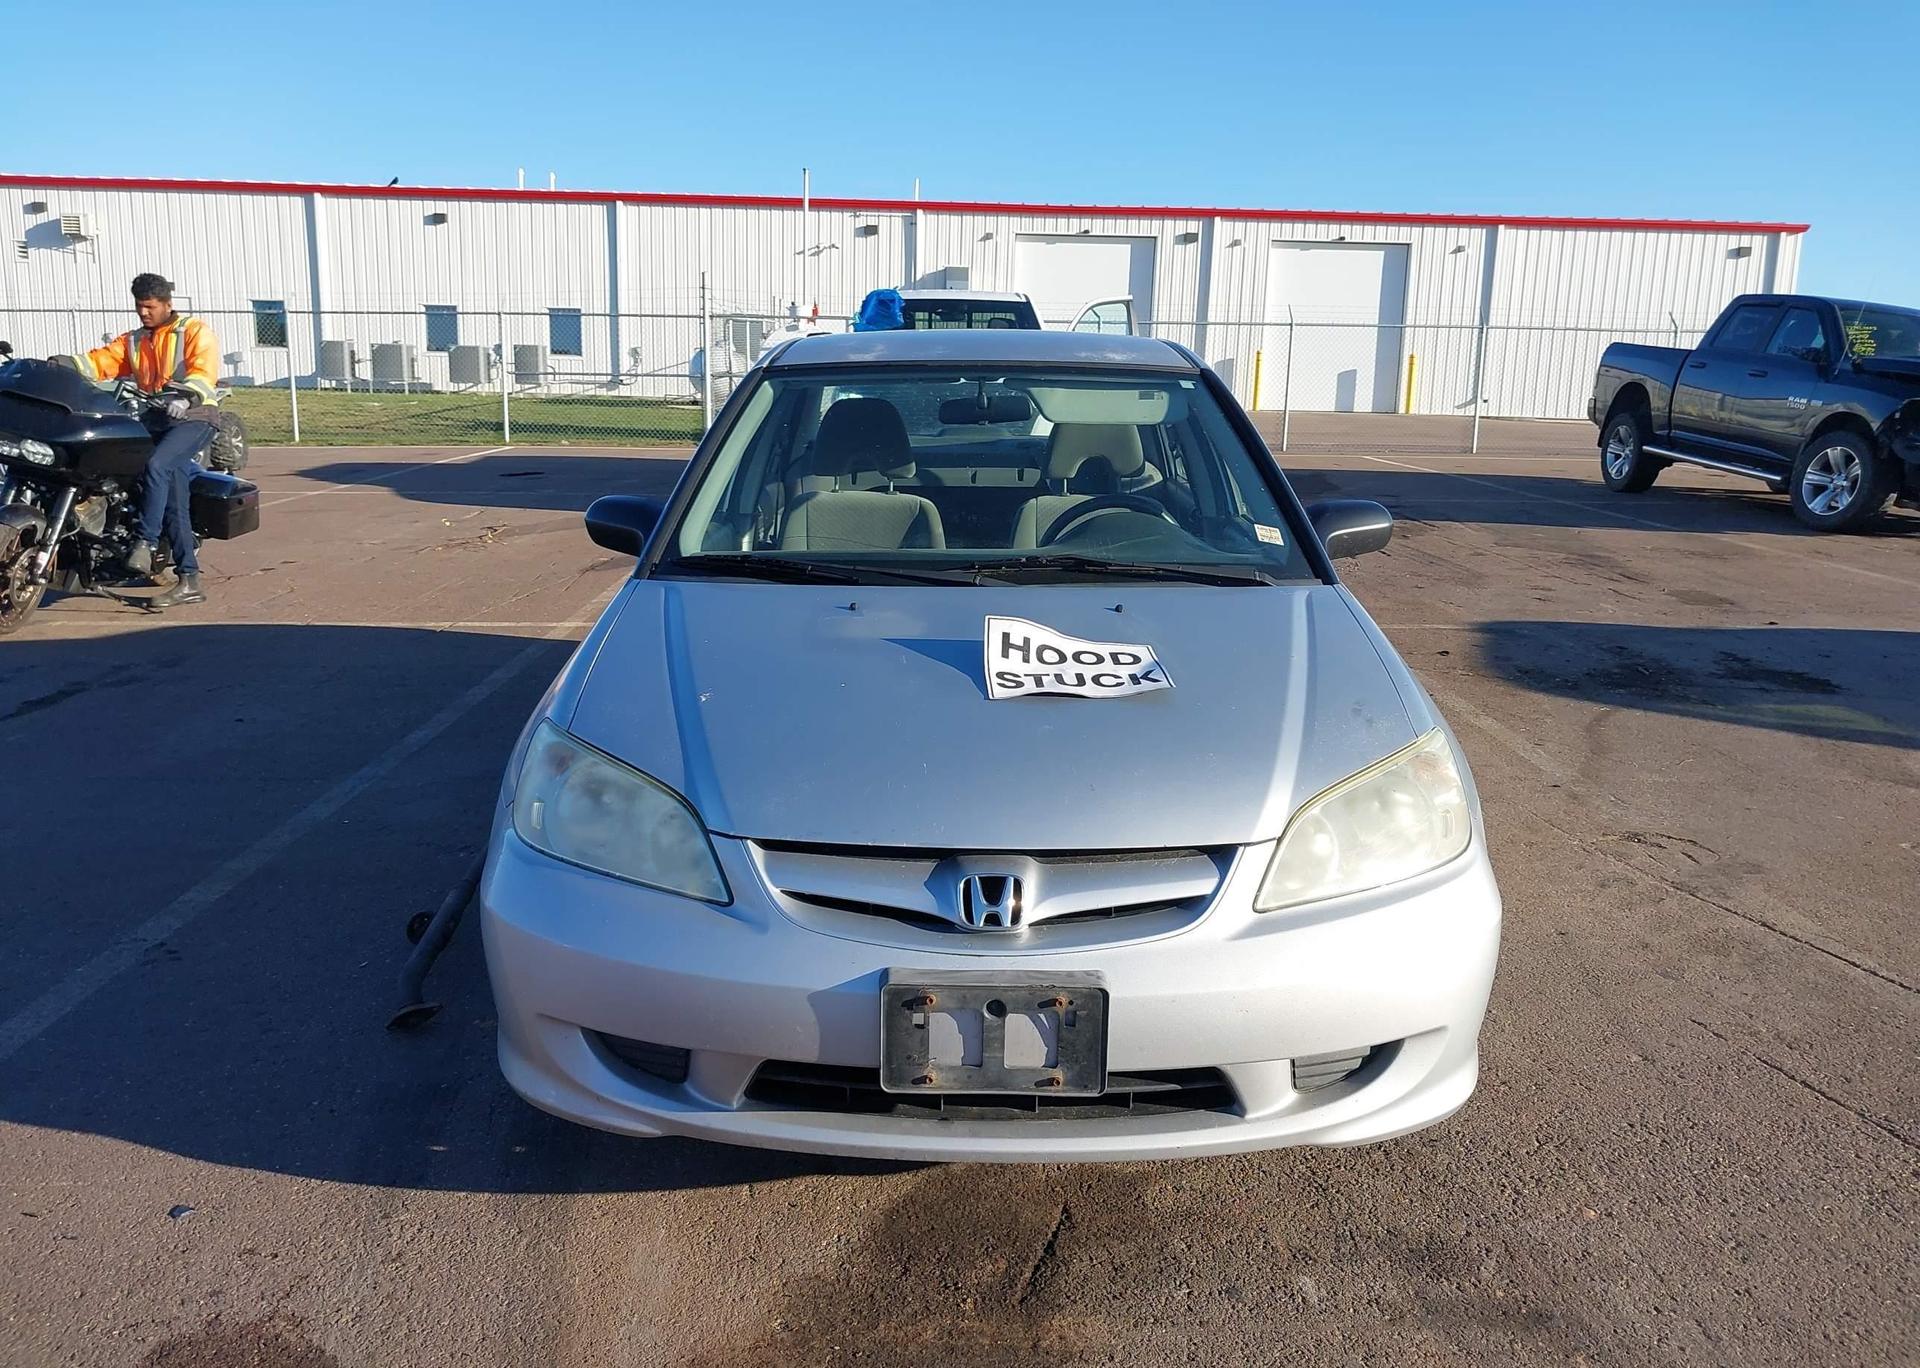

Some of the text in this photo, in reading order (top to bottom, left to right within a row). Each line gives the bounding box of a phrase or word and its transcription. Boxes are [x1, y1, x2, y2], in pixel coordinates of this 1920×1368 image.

[1788, 396, 1808, 404] RAM
[1001, 631, 1142, 666] HOOD
[995, 668, 1163, 689] STUCK
